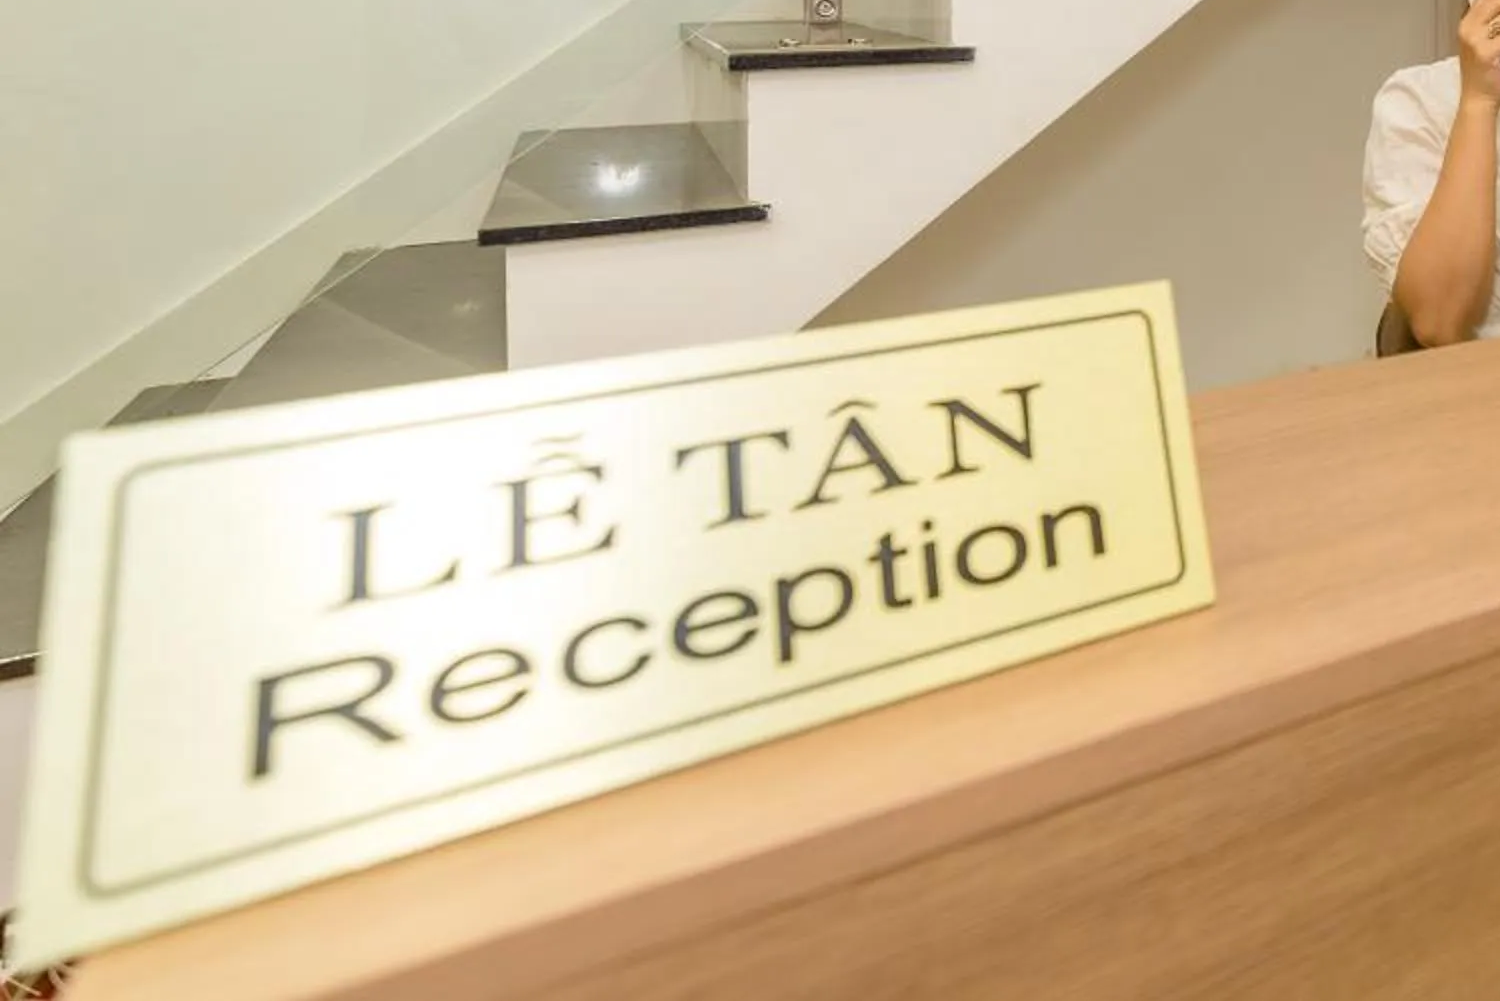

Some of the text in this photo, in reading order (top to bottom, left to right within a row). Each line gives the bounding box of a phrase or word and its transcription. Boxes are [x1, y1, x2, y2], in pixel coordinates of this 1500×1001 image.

[331, 383, 1043, 607] LỄ TÂN
[248, 502, 1108, 779] Reception
